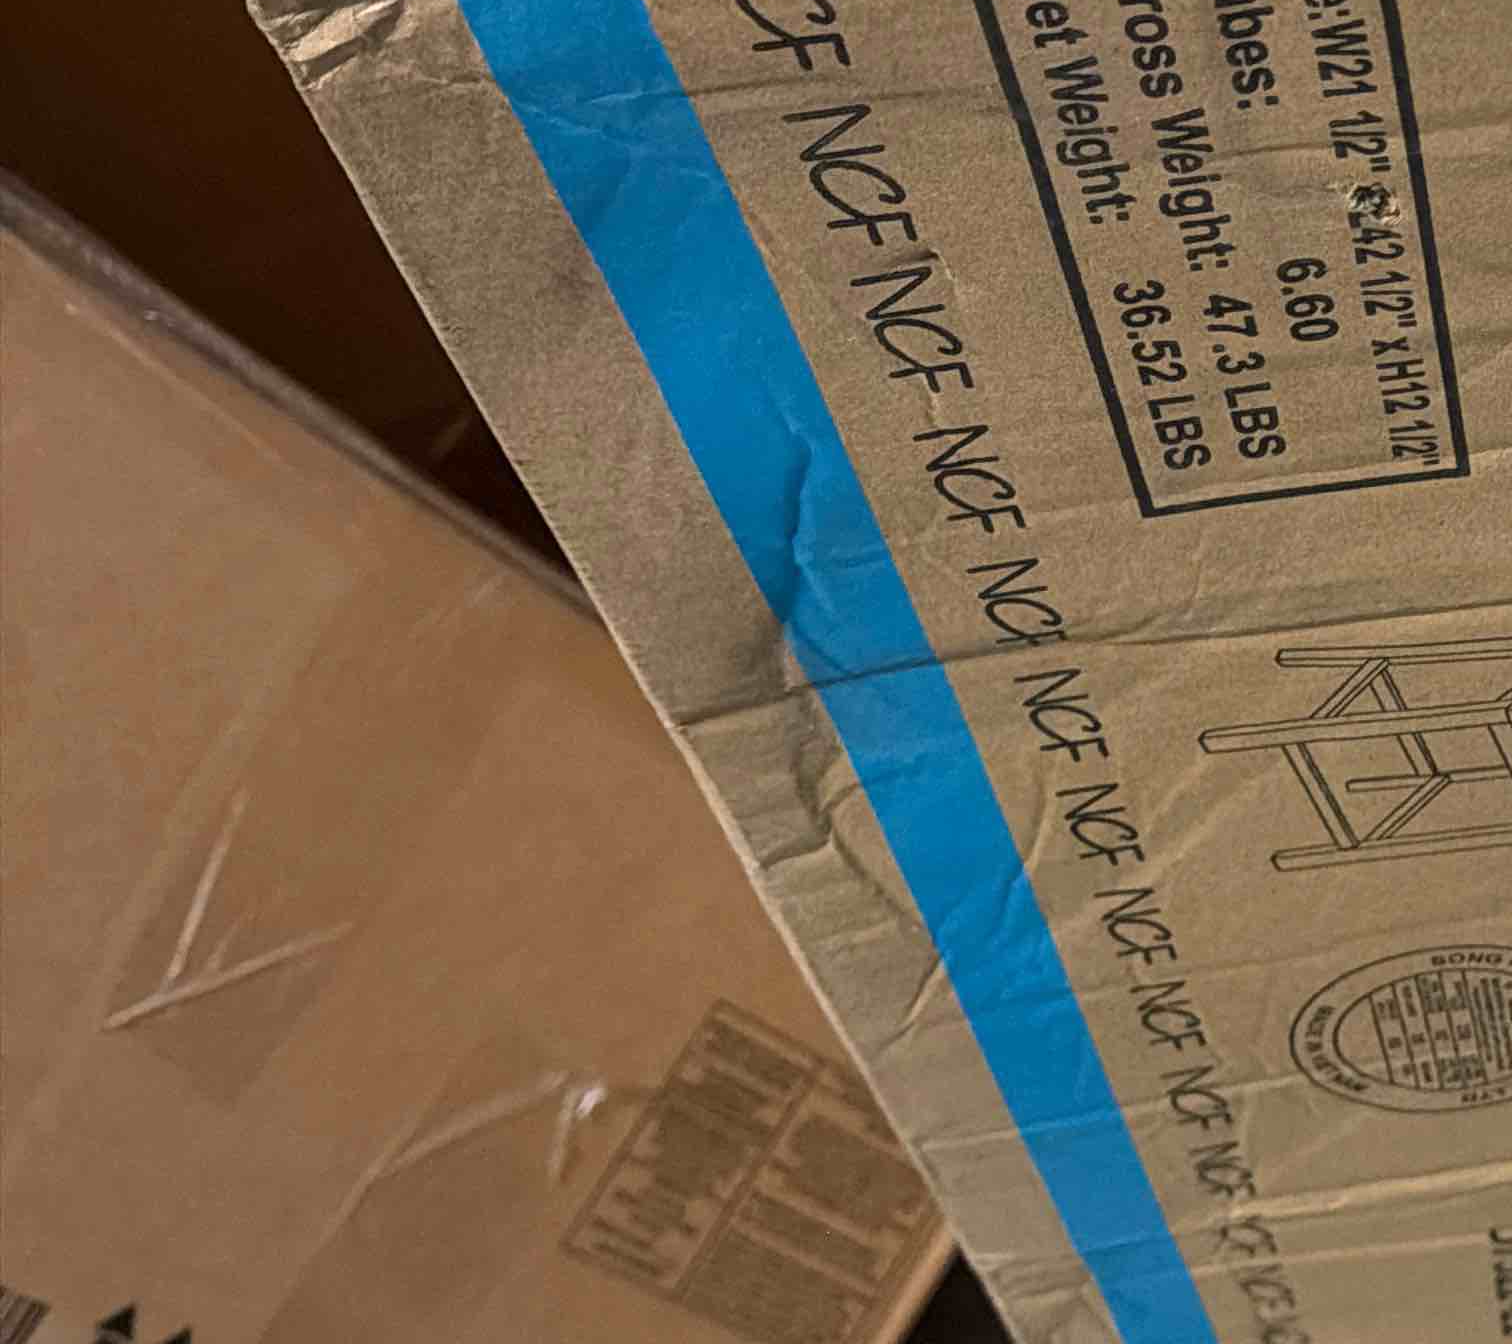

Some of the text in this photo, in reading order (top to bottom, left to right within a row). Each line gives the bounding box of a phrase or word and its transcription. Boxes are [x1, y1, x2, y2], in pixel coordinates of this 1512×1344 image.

[783, 104, 917, 247] NCF
[1043, 55, 1138, 225] Weight:
[1151, 107, 1235, 272] Weight:
[850, 266, 974, 393] NCF
[1113, 279, 1189, 386] 36.52
[1201, 293, 1266, 376] 47.3
[1276, 258, 1341, 343] 6.60
[1222, 381, 1287, 460] LBS
[1376, 358, 1431, 416] H12
[1147, 393, 1212, 471] LBS
[913, 425, 1026, 533] NCF
[967, 558, 1068, 646] NCF
[1013, 668, 1109, 762] NCF
[1056, 783, 1145, 866] NCF
[1094, 888, 1177, 965] NCF
[1130, 980, 1206, 1050] NCF
[1161, 1065, 1233, 1131] NCF
[1188, 1140, 1257, 1200] NCF
[1213, 1214, 1279, 1258] CF
